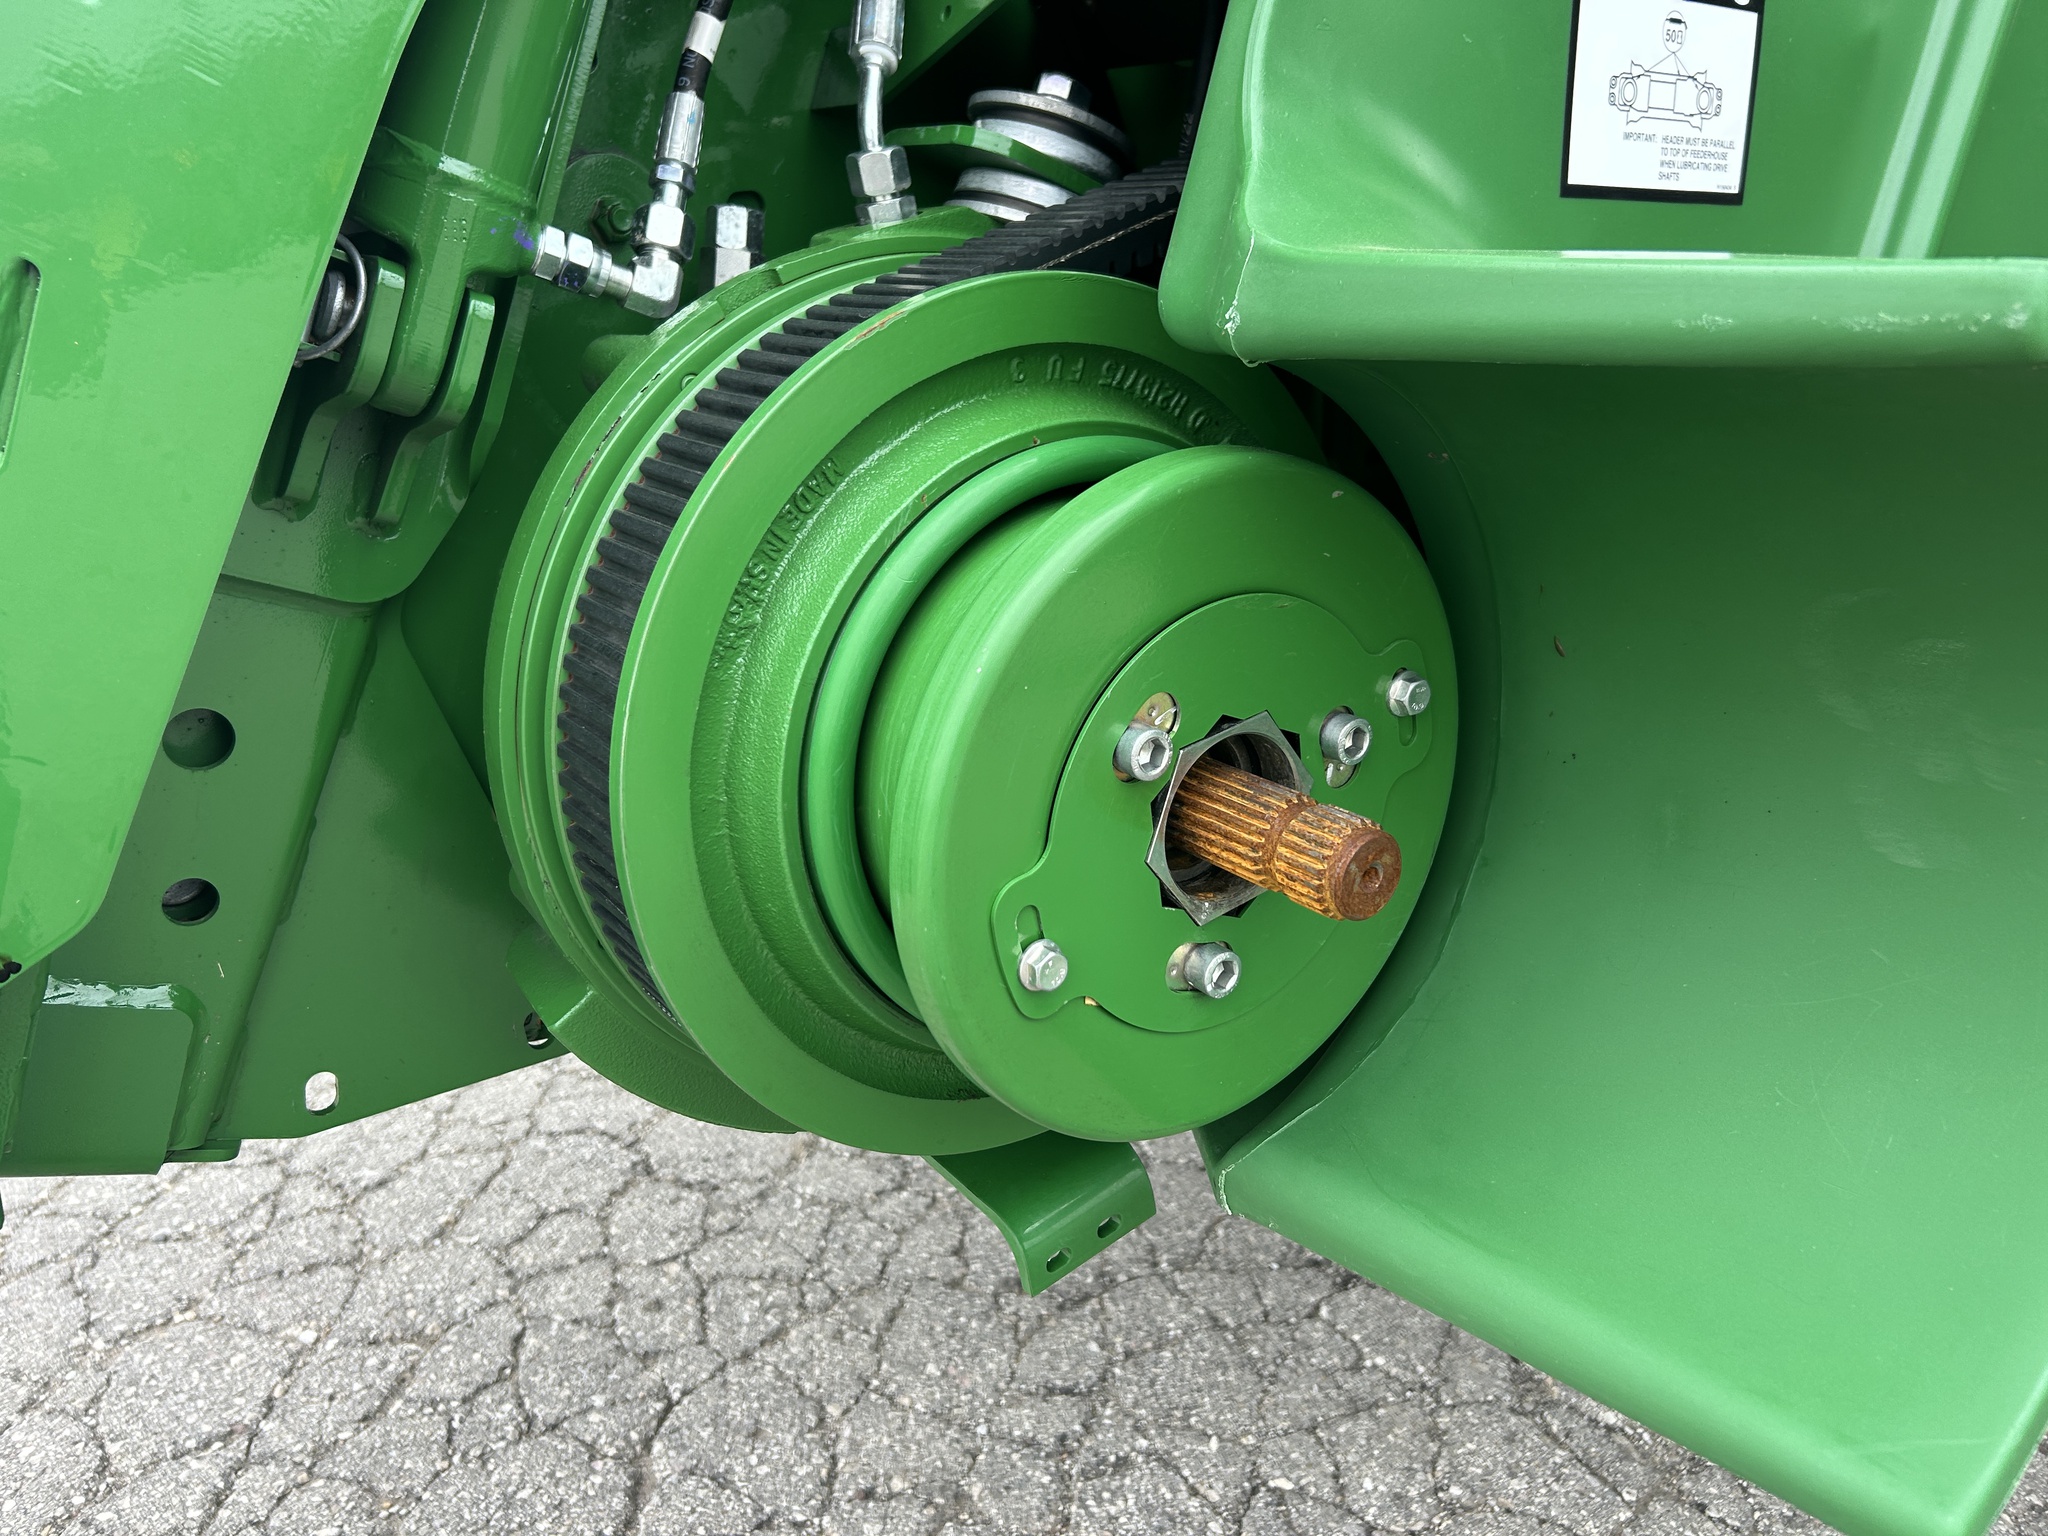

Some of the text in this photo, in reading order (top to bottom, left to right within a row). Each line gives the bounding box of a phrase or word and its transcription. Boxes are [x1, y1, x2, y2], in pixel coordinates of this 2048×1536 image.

[1623, 132, 1736, 150] IMPORTANT: HEADER MUST BE PARALLEL
[1661, 147, 1729, 161] TO TOP OF FEEDERHOUSE
[1659, 160, 1729, 173] WHEN LUBRICATING DRIVE
[1658, 171, 1680, 181] SHAFTS
[761, 457, 846, 562] MADE IN
